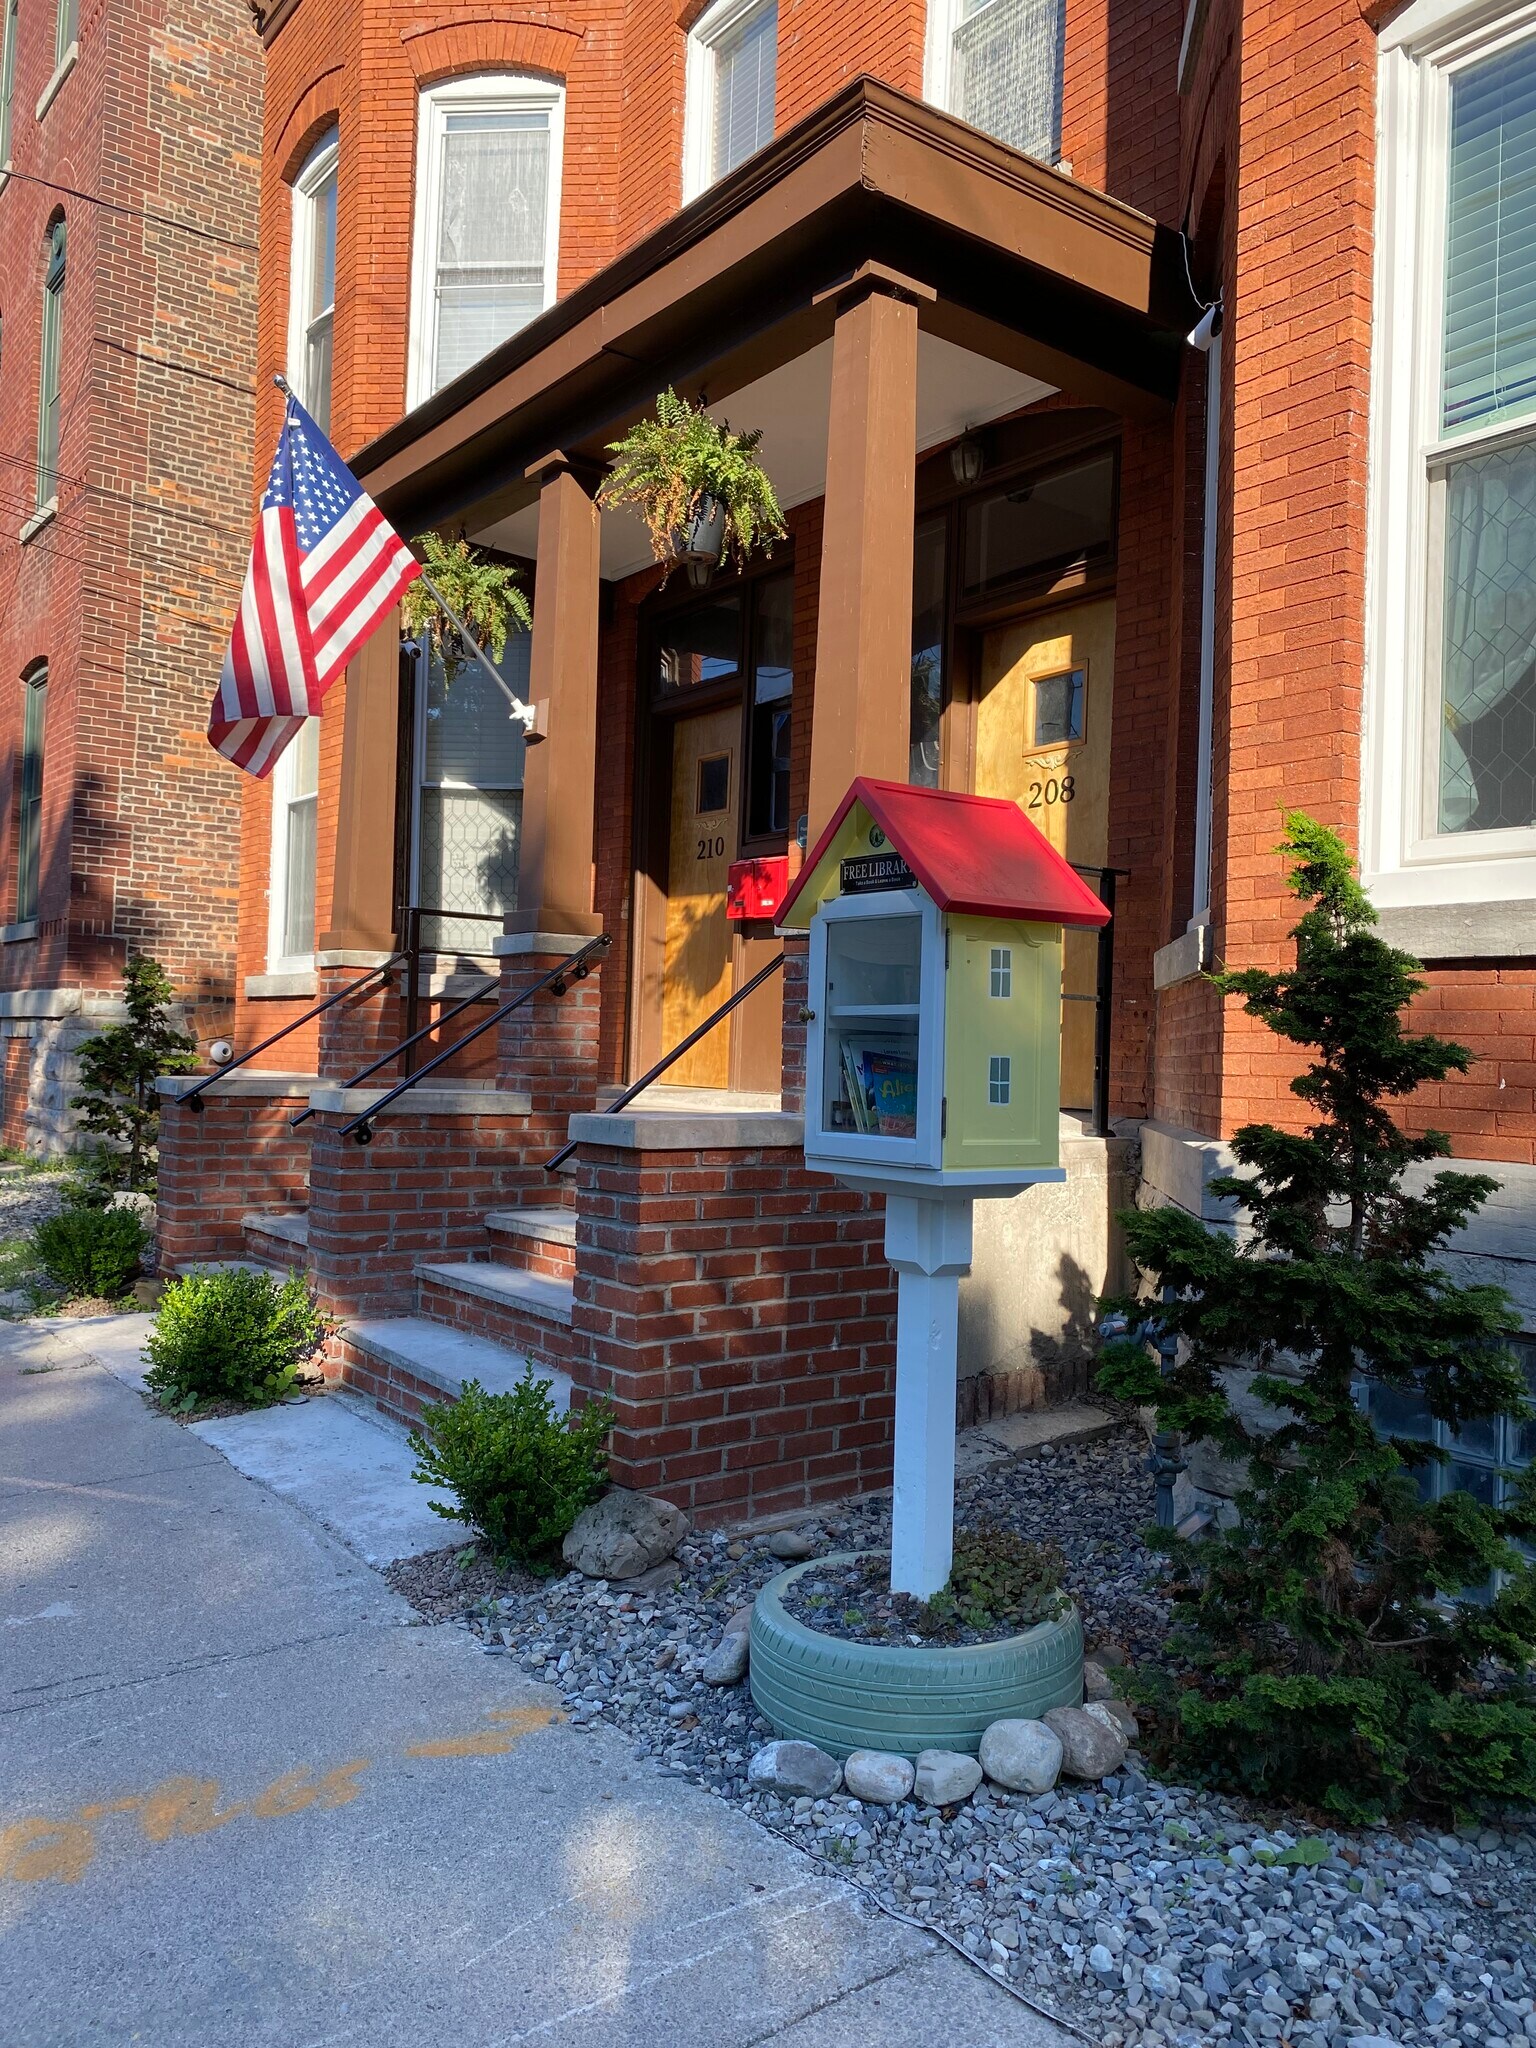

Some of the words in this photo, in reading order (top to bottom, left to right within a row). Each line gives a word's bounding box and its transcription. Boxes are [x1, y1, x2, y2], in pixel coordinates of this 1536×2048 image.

[1028, 775, 1076, 809] 208
[696, 836, 725, 860] 210
[843, 864, 868, 880] FREE
